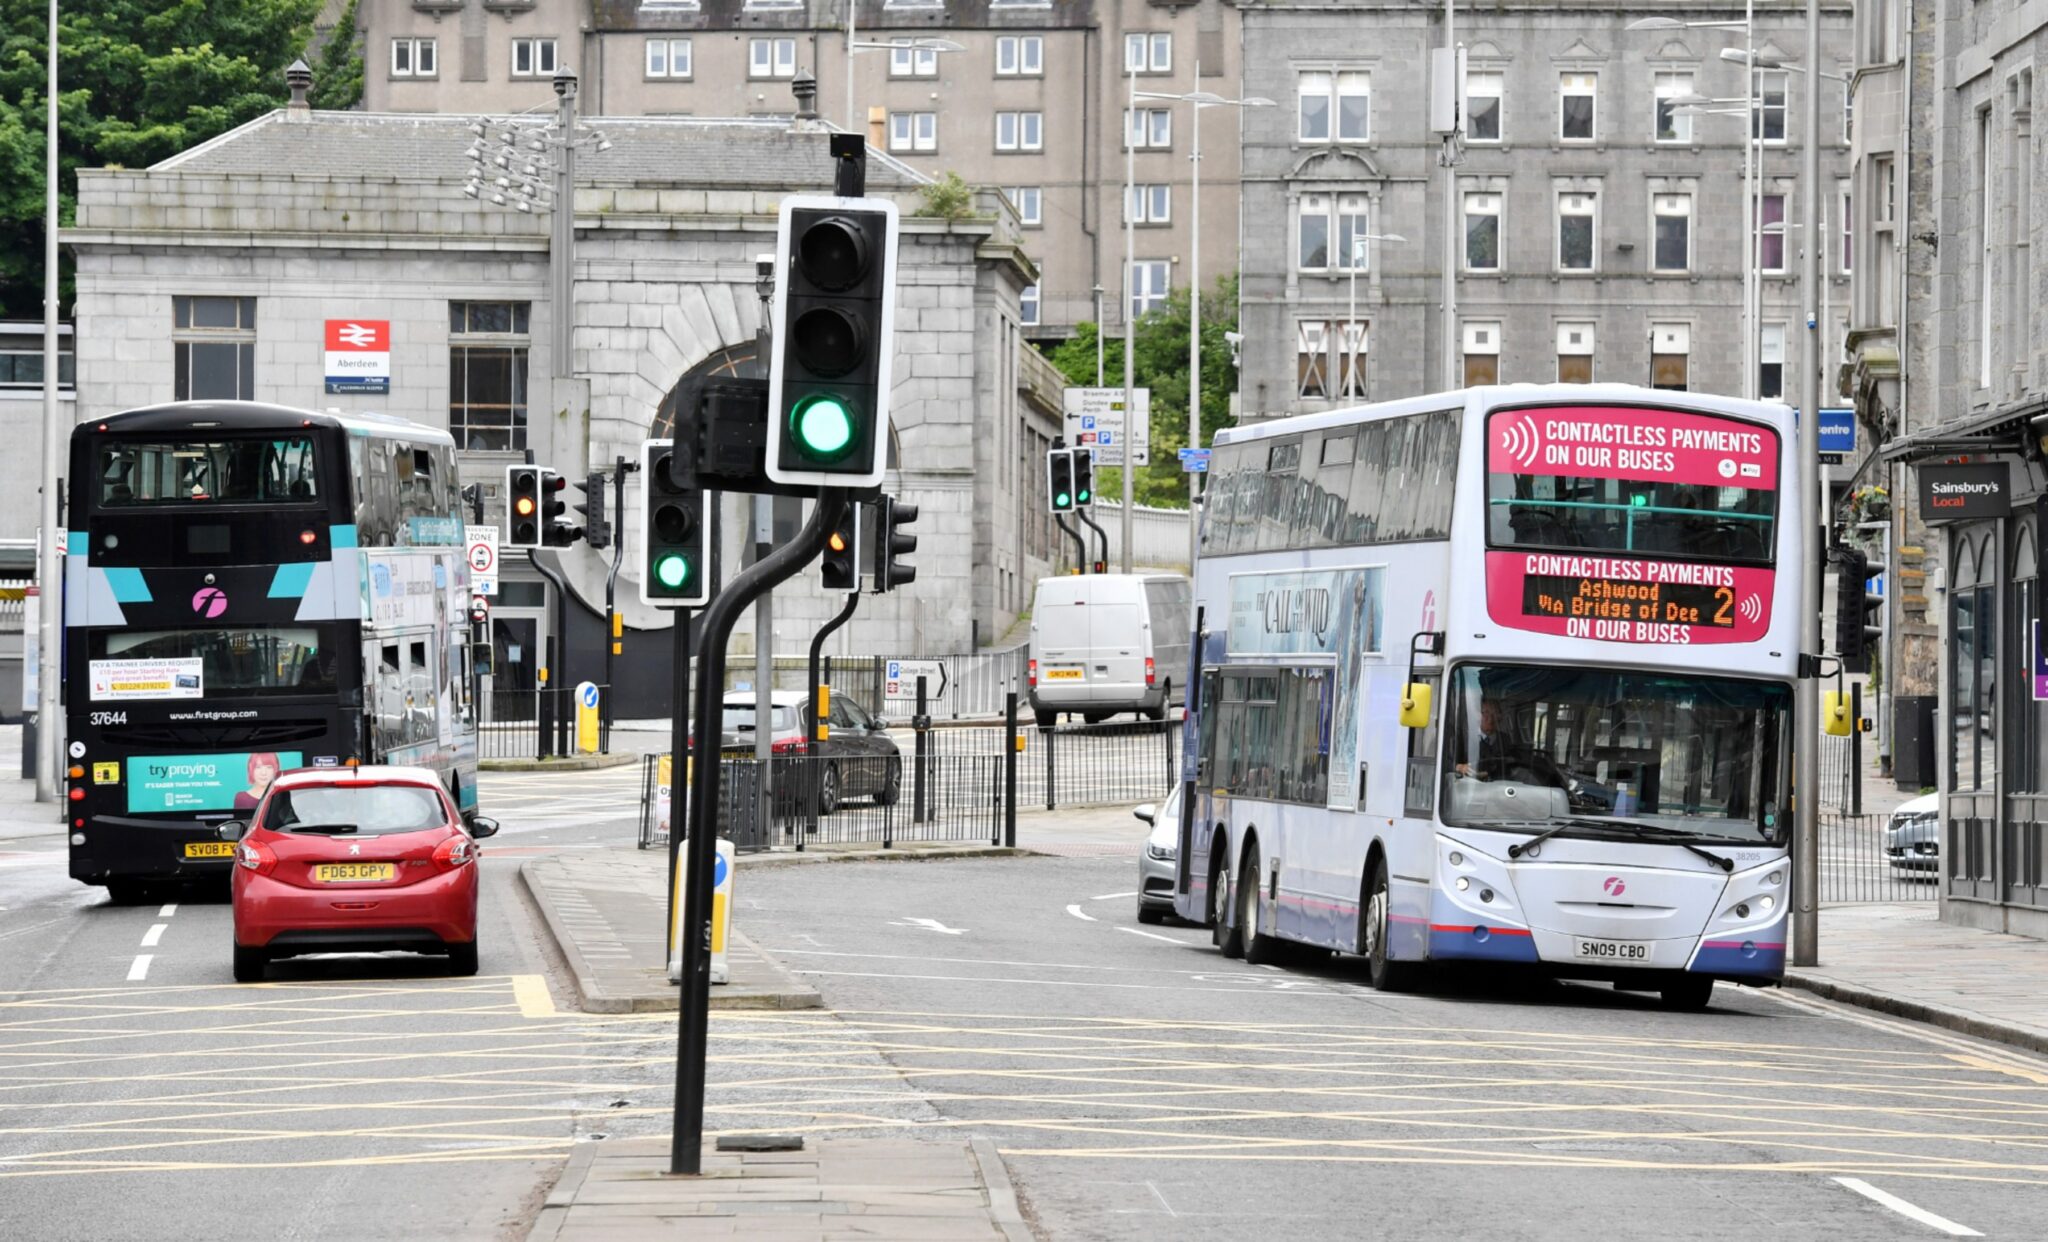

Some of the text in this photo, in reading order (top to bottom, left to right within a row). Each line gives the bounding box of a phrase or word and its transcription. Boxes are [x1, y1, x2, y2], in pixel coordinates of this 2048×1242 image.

[337, 359, 378, 368] Aberdeen
[1546, 419, 1762, 454] CONTACTLESS PAYMENTS
[1818, 423, 1850, 435] entre
[1546, 444, 1675, 472] ON OUR BUSES
[1932, 480, 1999, 495] Sainsbury's
[1932, 496, 1964, 508] Local
[1526, 554, 1734, 587] CONTACTLESS PAYMENTS
[1579, 578, 1660, 602] Ashwood
[1266, 590, 1292, 634] CALL
[1571, 596, 1631, 618] Bridge
[1640, 601, 1659, 620] of
[1666, 601, 1699, 622] Dee
[1713, 586, 1734, 624] 2
[1566, 616, 1691, 644] ON OUR BUSES
[90, 711, 127, 726] 37644
[170, 710, 258, 720] www.firstgroup.com
[189, 844, 220, 856] SV08
[1736, 852, 1760, 861] 38205
[321, 862, 386, 878] FD63 GPY
[1582, 942, 1616, 956] SN09
